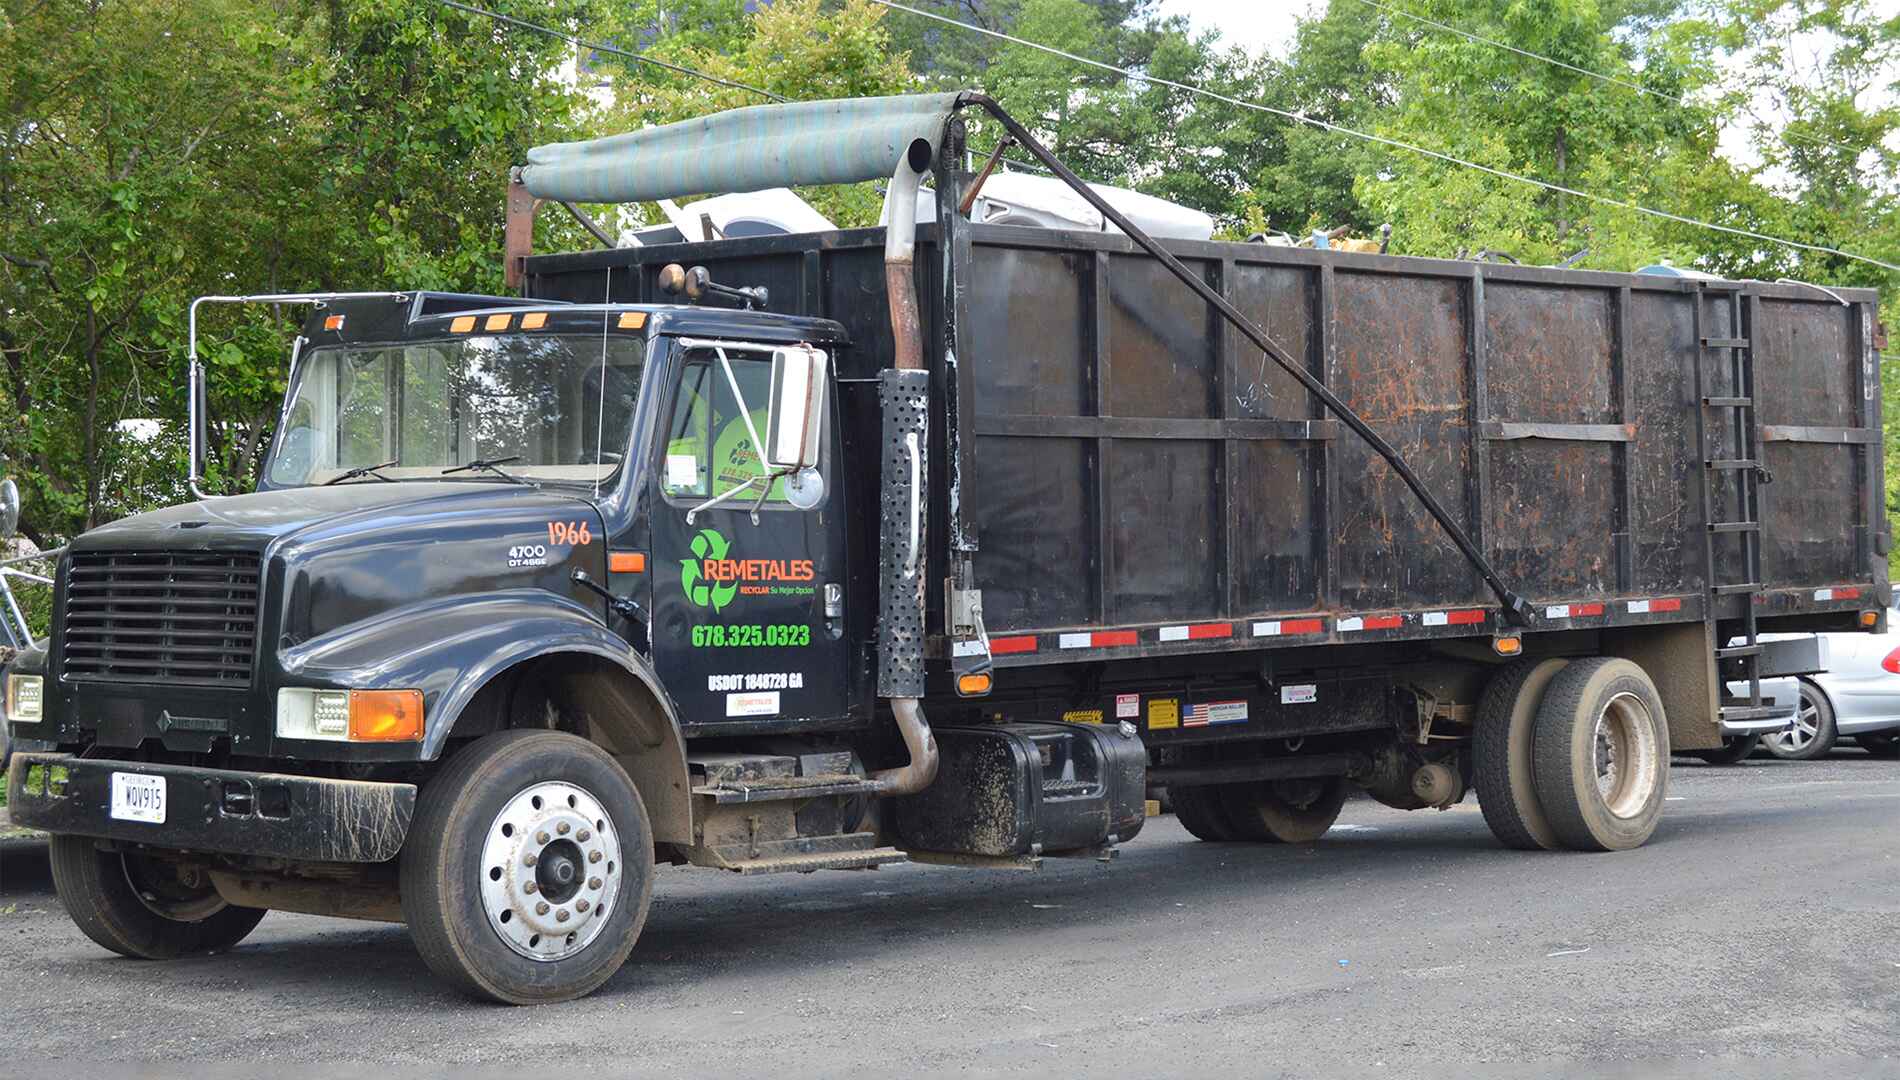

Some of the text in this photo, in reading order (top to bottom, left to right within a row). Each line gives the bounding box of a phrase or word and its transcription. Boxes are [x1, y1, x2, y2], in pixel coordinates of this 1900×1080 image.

[547, 521, 592, 545] 1966
[508, 545, 546, 558] 4700
[704, 559, 815, 581] REMETALES
[692, 624, 811, 647] 678.325.0323
[708, 675, 744, 691] USDOT
[789, 672, 803, 688] GA
[126, 785, 162, 810] WQV915
